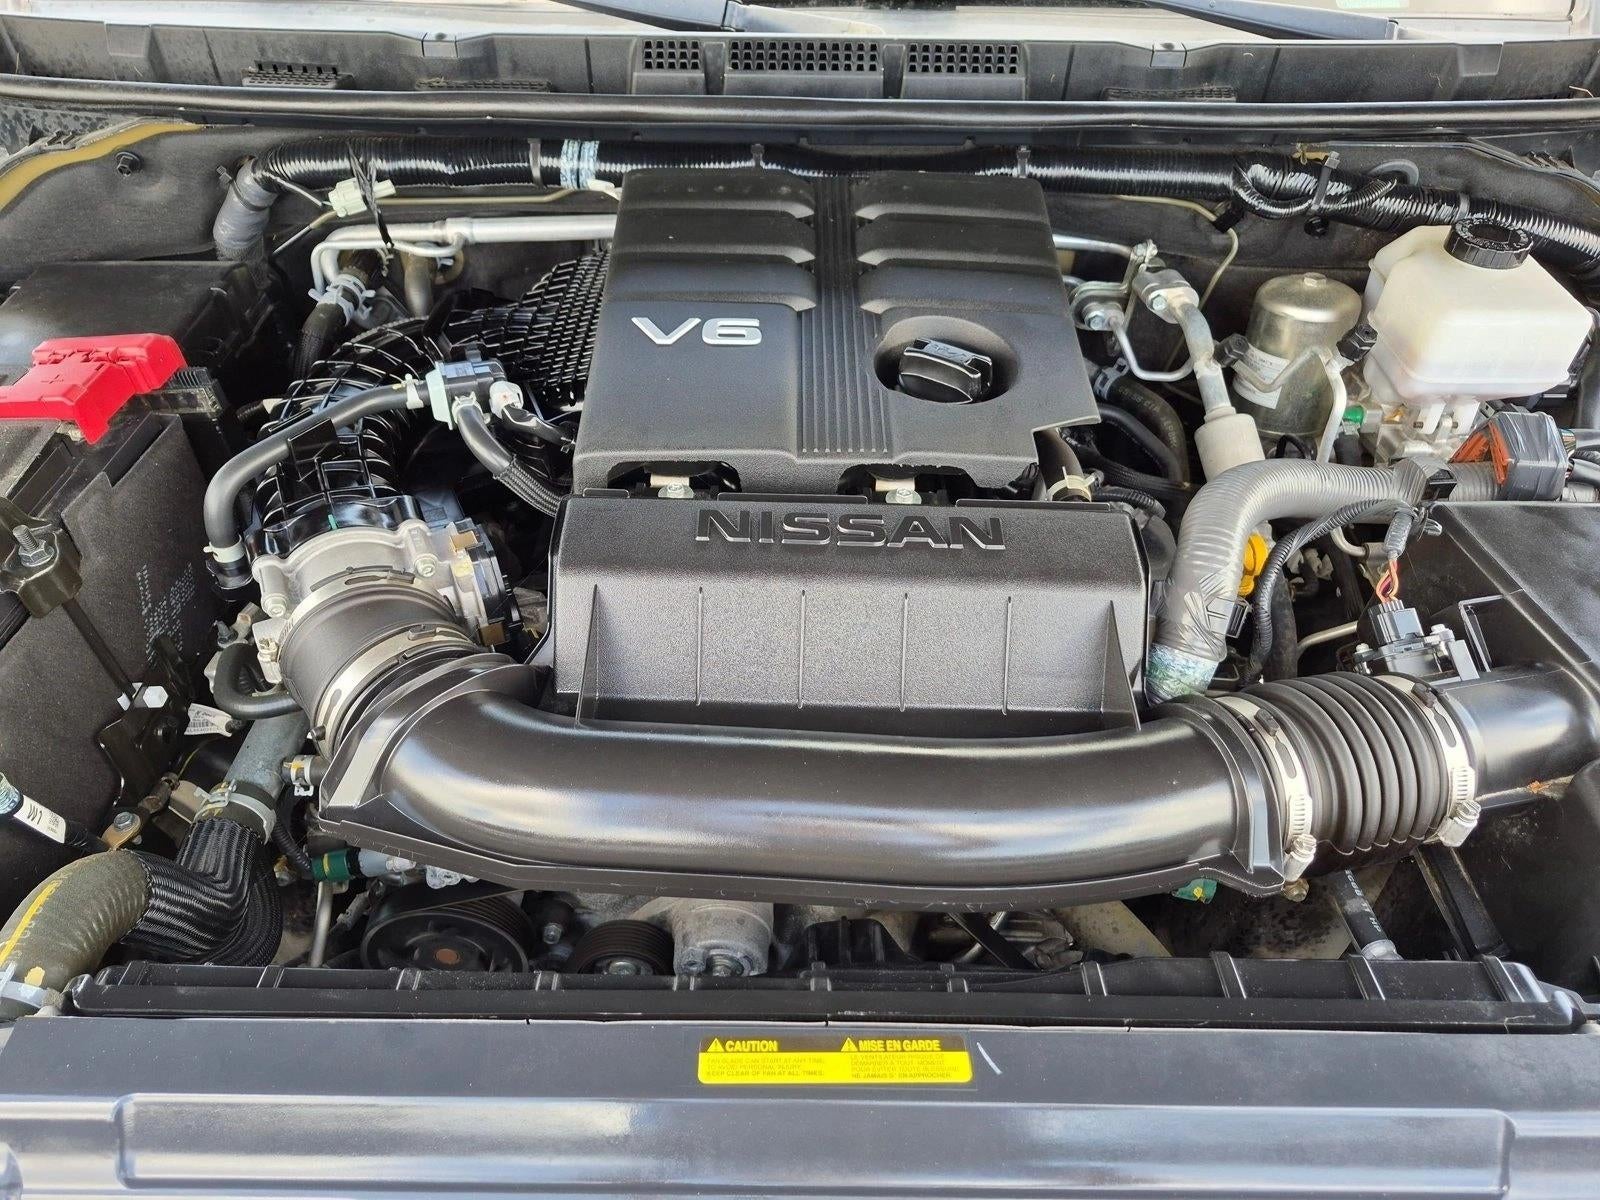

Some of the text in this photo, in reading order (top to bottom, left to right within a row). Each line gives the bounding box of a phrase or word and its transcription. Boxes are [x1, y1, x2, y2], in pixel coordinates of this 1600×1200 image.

[631, 317, 762, 345] V6
[696, 509, 1005, 549] NISSAN
[725, 1040, 779, 1052] CAUTION
[858, 1039, 941, 1052] MISE EN GARDE
